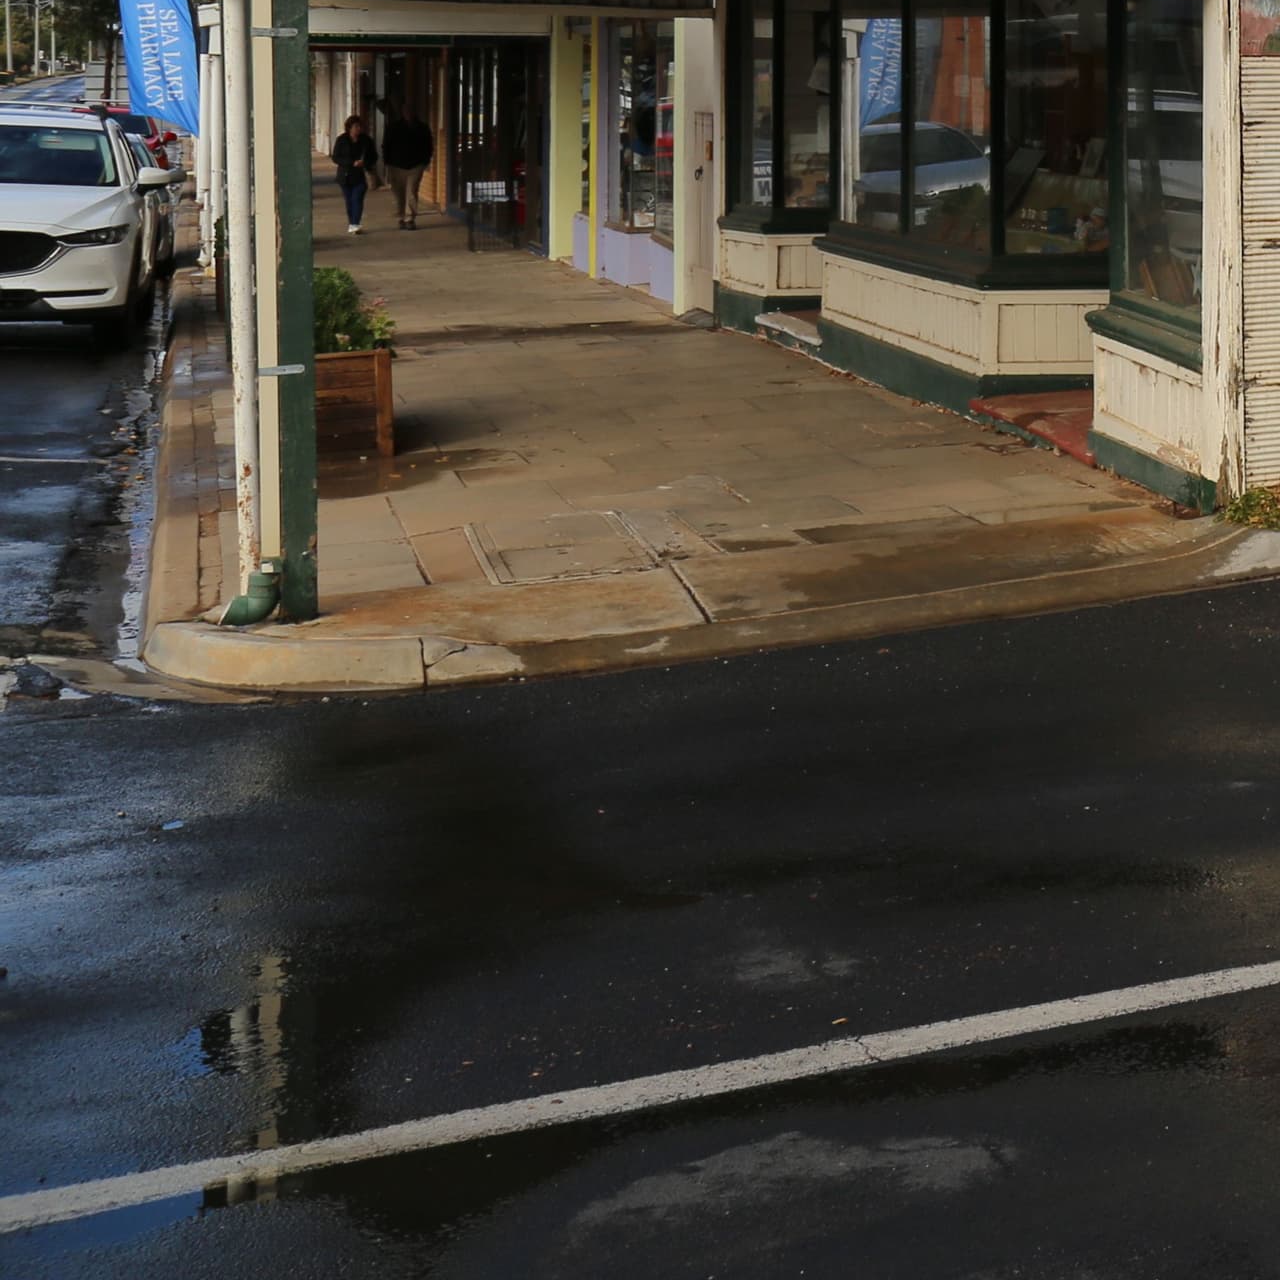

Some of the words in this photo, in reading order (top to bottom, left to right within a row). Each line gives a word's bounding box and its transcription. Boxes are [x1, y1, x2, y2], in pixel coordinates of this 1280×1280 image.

[159, 8, 180, 45] SEA
[136, 2, 165, 110] PHARMACY
[162, 52, 185, 102] LAKE
